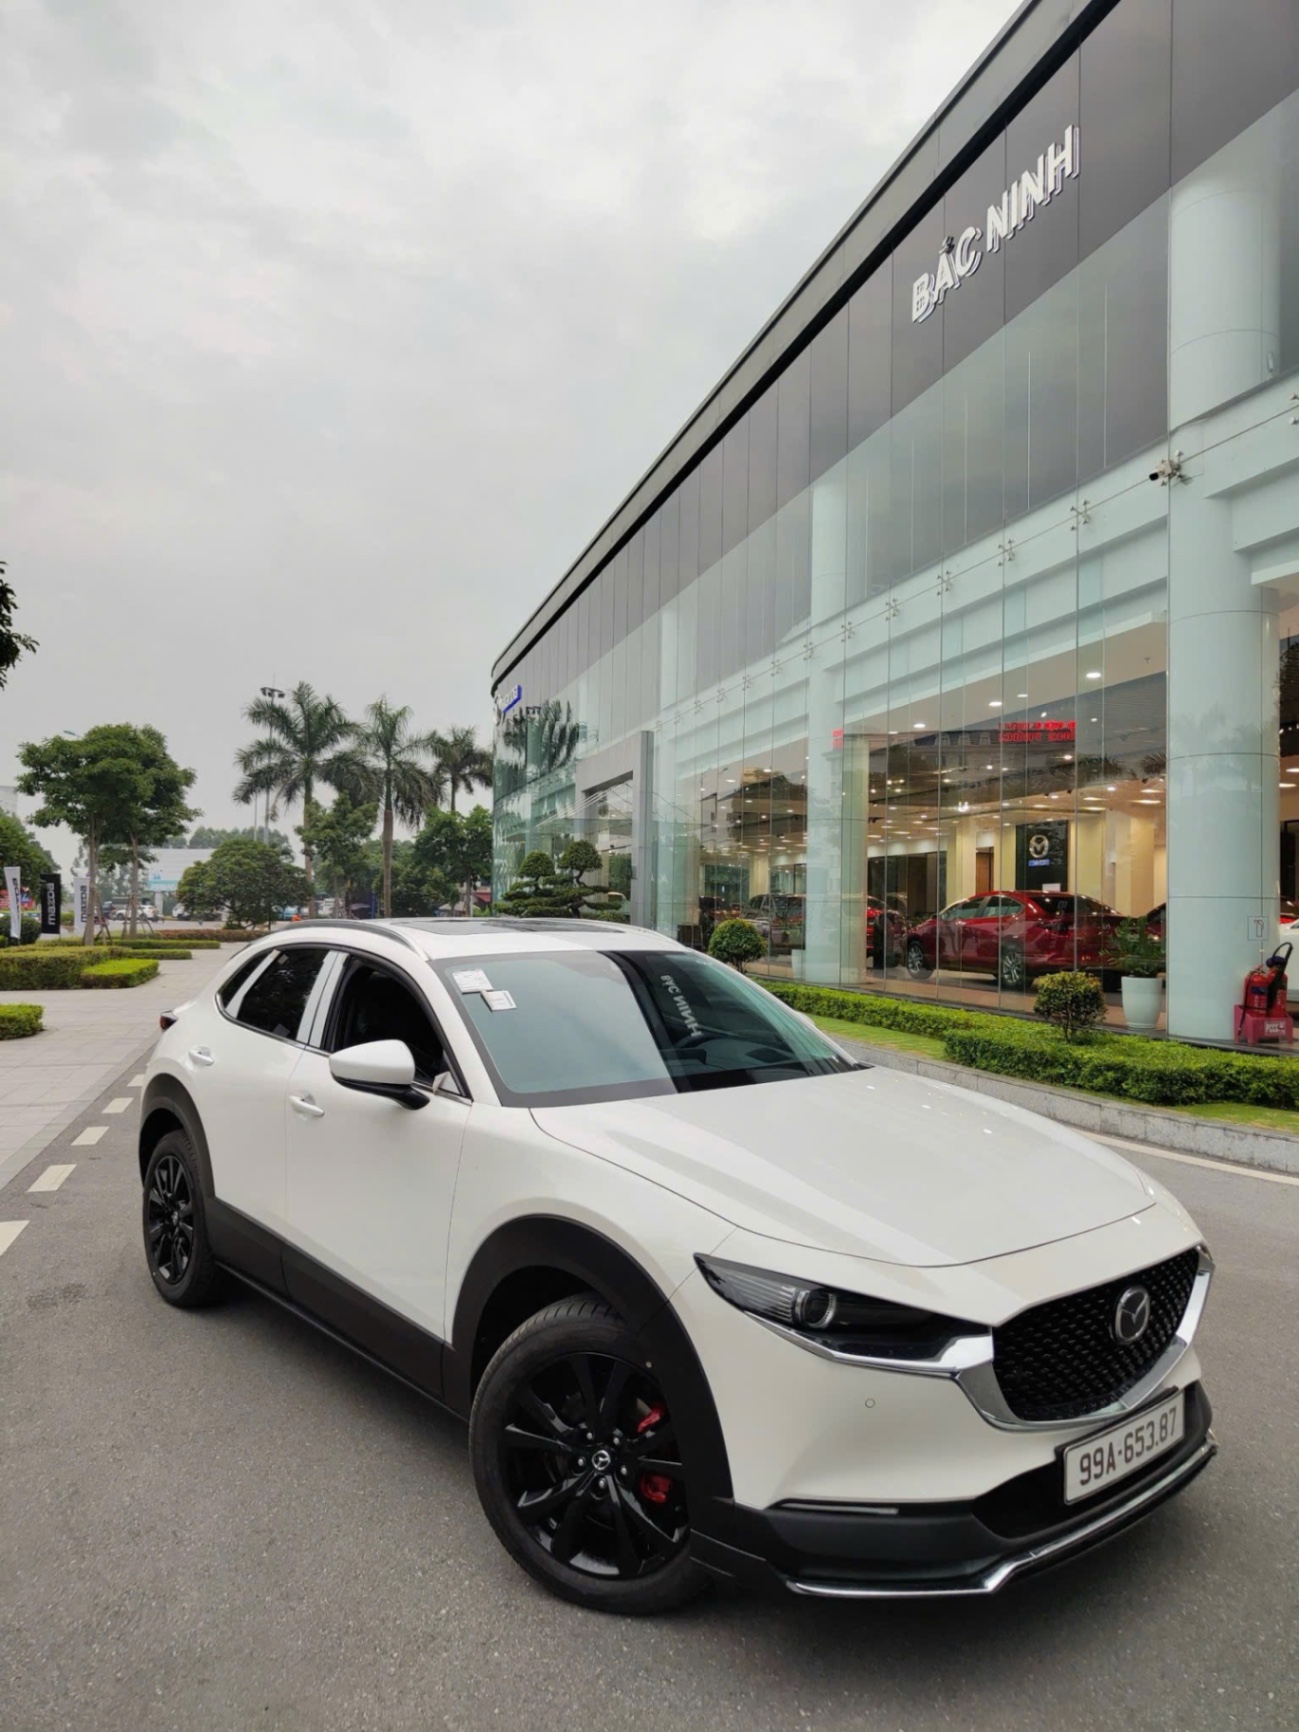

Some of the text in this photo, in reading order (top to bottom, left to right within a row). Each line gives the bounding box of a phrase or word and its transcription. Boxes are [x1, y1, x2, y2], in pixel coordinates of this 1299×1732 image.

[986, 124, 1080, 253] NINH
[46, 882, 56, 926] mazda
[1079, 1405, 1177, 1487] 99A-653.87
